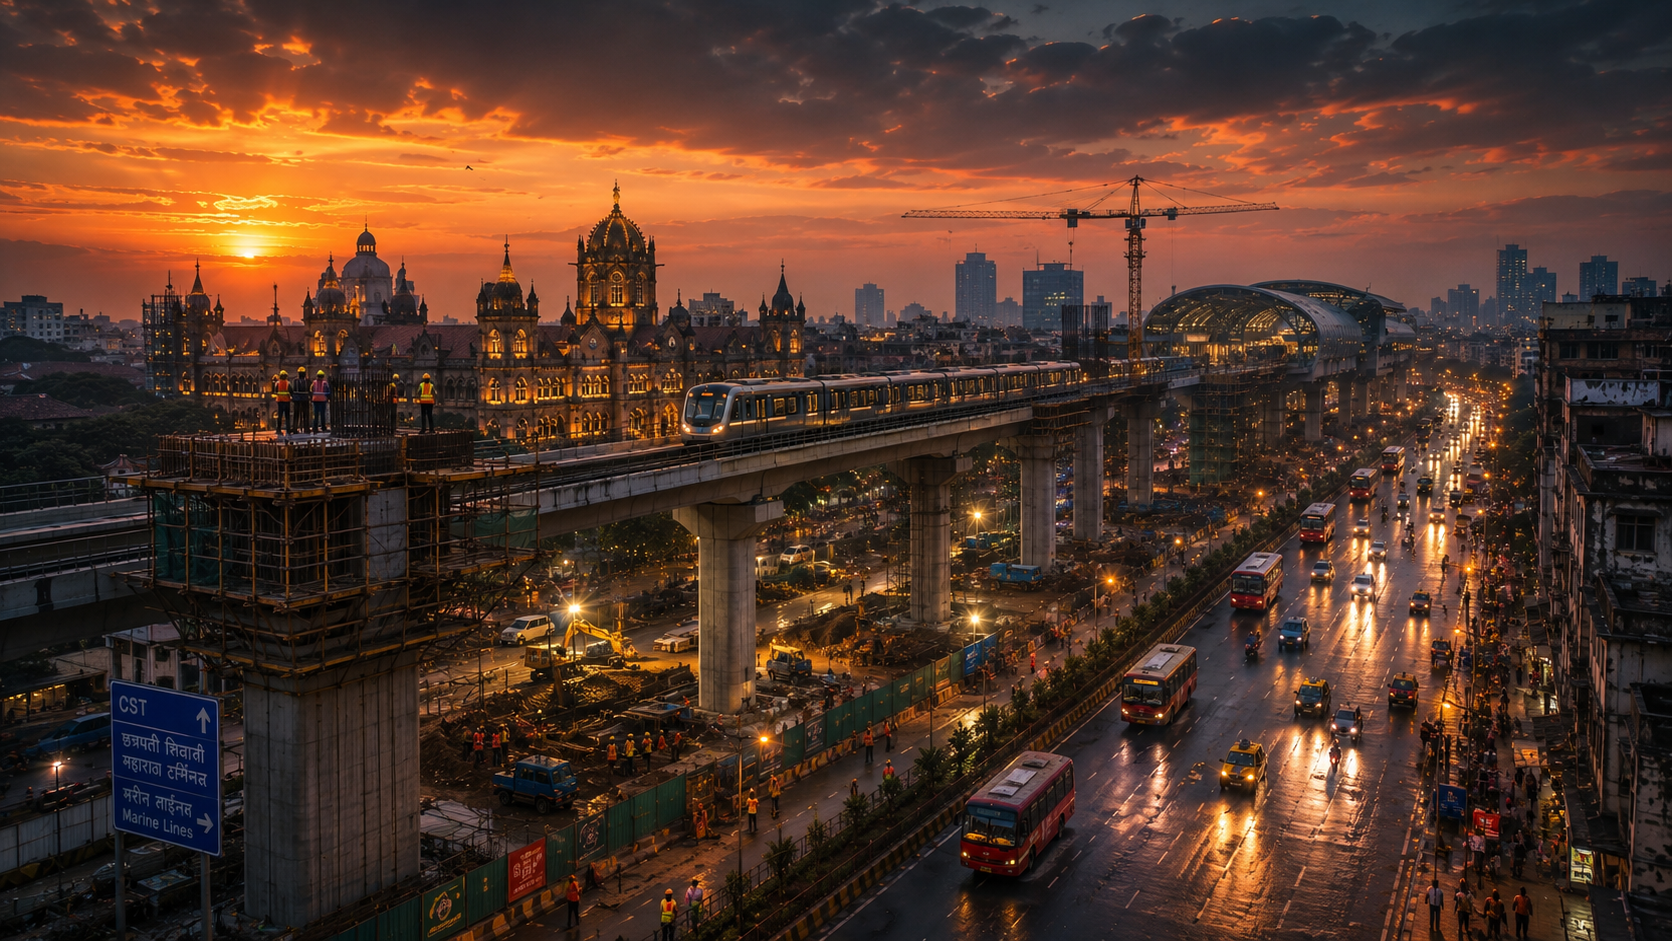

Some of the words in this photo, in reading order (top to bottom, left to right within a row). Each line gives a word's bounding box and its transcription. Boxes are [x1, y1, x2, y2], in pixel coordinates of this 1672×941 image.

[119, 695, 147, 717] CST
[122, 808, 159, 830] Marine
[163, 818, 193, 839] Lines
